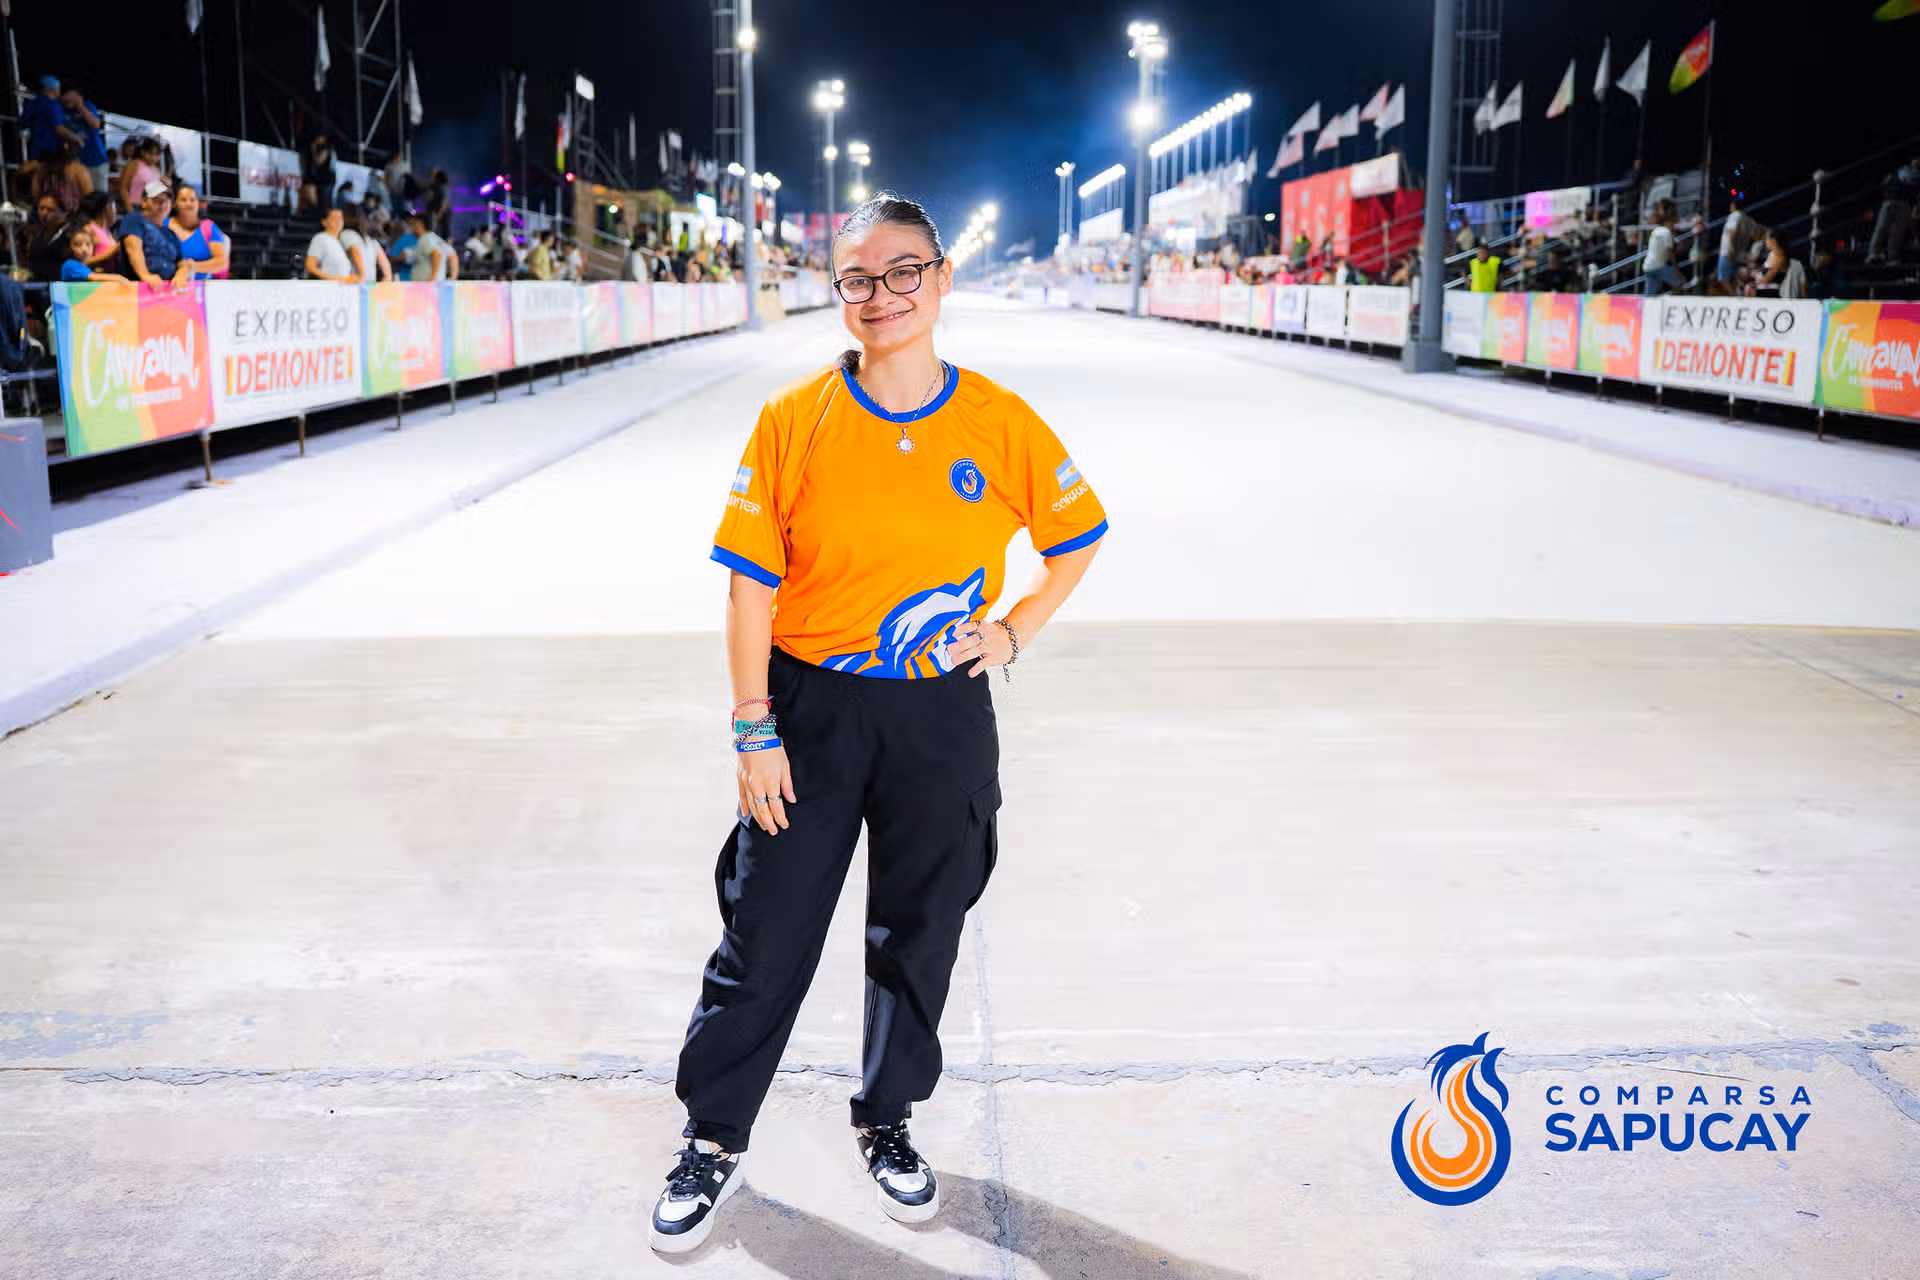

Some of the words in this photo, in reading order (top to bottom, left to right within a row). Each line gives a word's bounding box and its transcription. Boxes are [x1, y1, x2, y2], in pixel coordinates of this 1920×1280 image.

[235, 306, 349, 337] EXPRESO
[1665, 305, 1795, 334] EXPRESO
[236, 345, 345, 395] DEMONTE
[1662, 339, 1784, 385] DEMONTE
[1051, 481, 1089, 512] CORRIE
